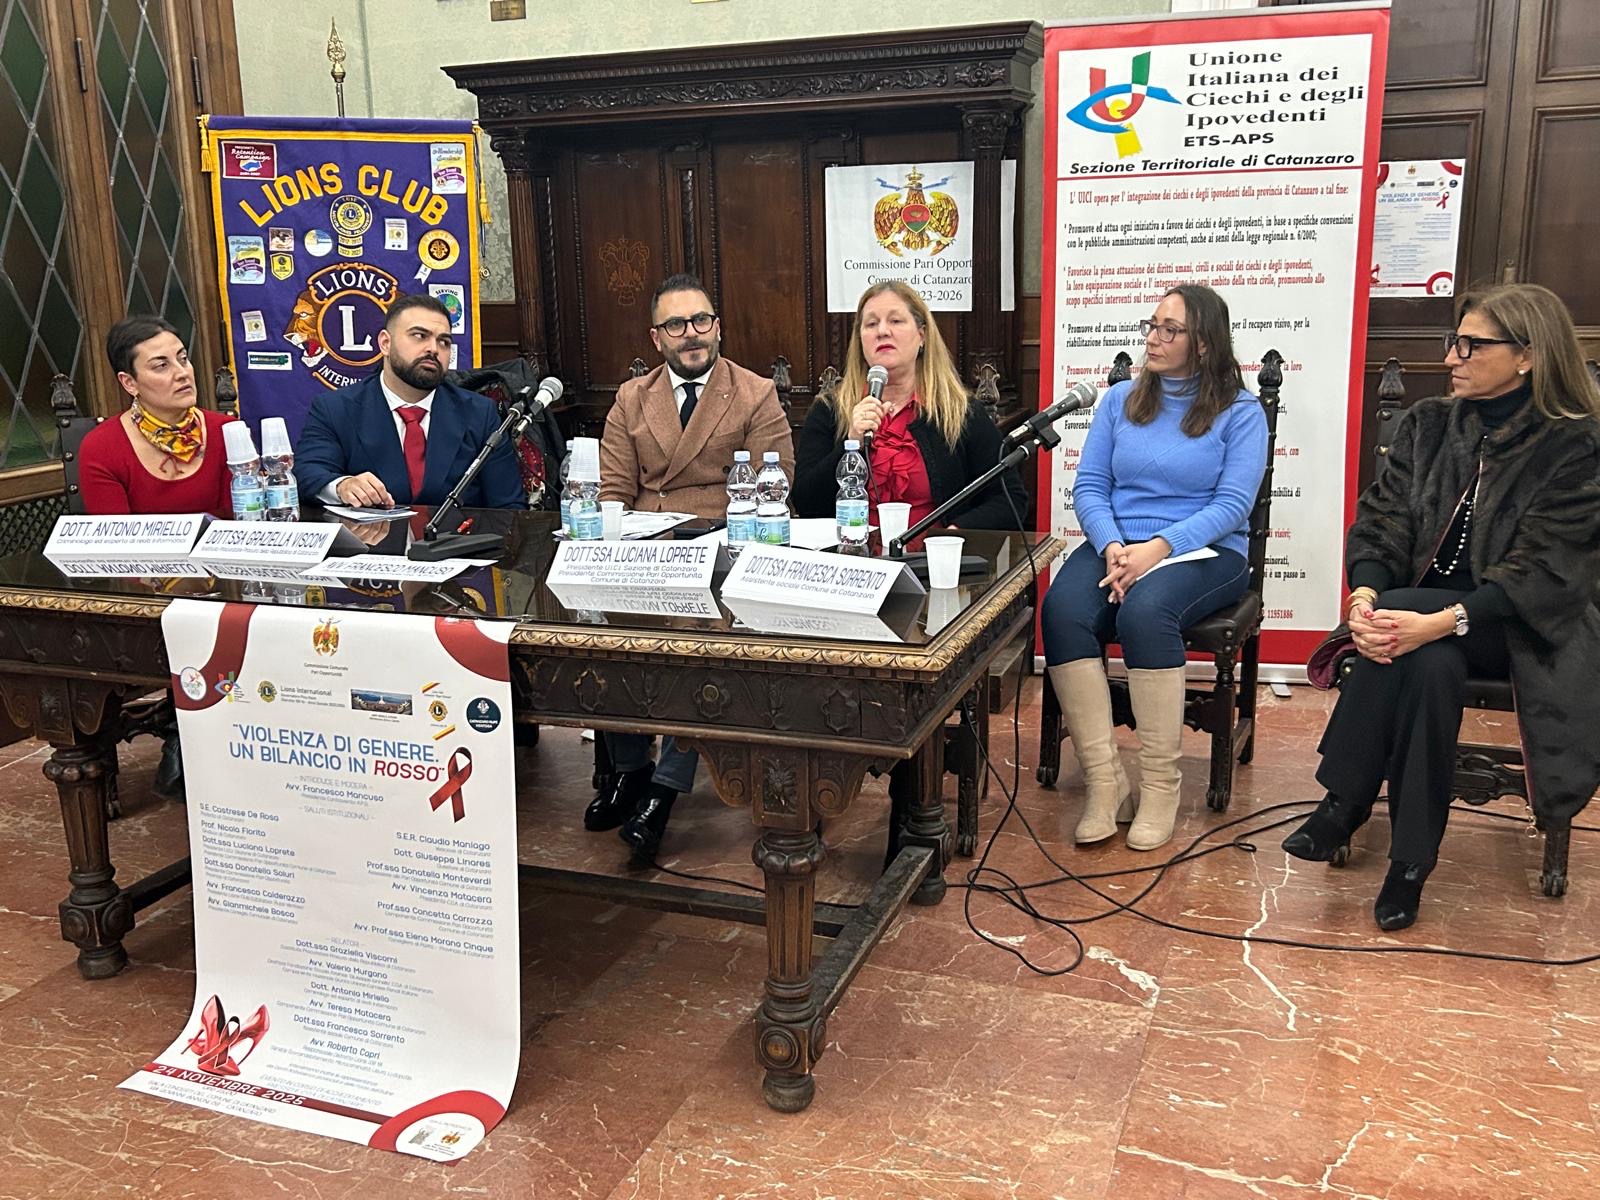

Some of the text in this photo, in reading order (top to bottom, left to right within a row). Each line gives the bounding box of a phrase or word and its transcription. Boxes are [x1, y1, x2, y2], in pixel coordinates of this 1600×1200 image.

[1189, 51, 1282, 66] Unione
[1186, 66, 1338, 86] Italiana dei
[1186, 86, 1364, 107] Ciechi e degli
[1185, 108, 1327, 129] Ipovedenti
[1184, 133, 1274, 147] ETS-APS
[1069, 153, 1354, 174] Sezione Territoriale di Catanzaro
[239, 163, 342, 227] LIONS
[358, 165, 448, 226] CLUB
[1078, 191, 1092, 203] UICI
[1094, 196, 1109, 206] opera
[1111, 195, 1120, 206] per
[1128, 191, 1160, 204] integrazione
[1163, 190, 1171, 200] dei
[1173, 189, 1188, 199] ciechi
[1195, 188, 1209, 202] degli
[1211, 187, 1240, 201] ipovedenti
[1242, 186, 1254, 197] della
[1257, 185, 1282, 199] provincia
[1285, 185, 1290, 195] di
[1292, 185, 1318, 195] Catanzaro
[1336, 183, 1348, 194] fine:
[1069, 224, 1094, 233] Promuove
[1096, 223, 1102, 232] ed
[1104, 223, 1118, 232] attua
[1120, 221, 1132, 234] ogni
[1134, 221, 1159, 231] iniziativa
[1166, 219, 1183, 230] favore
[1185, 219, 1193, 229] dei
[1195, 218, 1211, 229] ciechi
[1218, 217, 1231, 231] degli
[1234, 216, 1264, 230] ipovedenti,
[1266, 216, 1272, 226] in
[1274, 215, 1286, 226] base
[1293, 214, 1318, 228] specifiche
[1320, 214, 1353, 225] convenzioni
[844, 260, 910, 270] Commissione
[914, 259, 933, 268] Pari
[316, 270, 389, 296] LIONS
[911, 275, 920, 284] di
[918, 290, 962, 300] 23-2026
[339, 305, 373, 350] L
[1232, 318, 1309, 332] per il recupero visivo, per la
[318, 365, 361, 386] INTERN
[60, 521, 192, 536] DOTT. ANTONIO MIRIELLO
[292, 532, 329, 548] VISCOMI
[563, 547, 708, 563] DOTT.SSA LUCIANA LOPRETE
[787, 562, 838, 584] FRANCESCA
[836, 567, 887, 590] SORRENTO
[741, 576, 775, 587] Assistente
[776, 581, 799, 589] sociale
[801, 584, 829, 593] Comune
[839, 589, 874, 599] Catanzaro
[230, 741, 254, 760] UN
[261, 746, 341, 771] BILANCIO
[350, 756, 366, 773] IN
[334, 735, 351, 752] DI
[359, 738, 439, 763] GENERE.
[286, 783, 301, 791] Avv.
[303, 785, 344, 796] Francesco
[346, 790, 384, 802] Mancuso
[248, 810, 258, 818] De
[260, 812, 279, 821] Rosa
[201, 820, 215, 829] Prof.
[218, 824, 240, 833] Nicola
[242, 827, 266, 837] Fiorita
[233, 841, 263, 852] Luciana
[265, 846, 295, 856] Loprete
[419, 835, 450, 846] Claudio
[453, 840, 490, 851] Maniago
[394, 848, 413, 858] Dott.
[416, 852, 454, 864] Giuseppe
[457, 858, 490, 868] Linares
[235, 863, 272, 875] Donatella
[402, 866, 440, 879] Donatella
[442, 872, 491, 885] Monteverdi
[207, 881, 305, 904] Avv. Francesco Calderazzo
[412, 907, 450, 920] Concetta
[452, 914, 492, 926] Carrozza
[354, 923, 369, 931] Avv.
[406, 932, 428, 942] Elena
[431, 936, 461, 948] Morano
[463, 942, 493, 953] Cinque
[330, 945, 364, 958] Graziella
[366, 951, 398, 963] Viscomi
[309, 959, 388, 979] Avv. Valerio Murgano
[311, 981, 389, 1003] Dott. Antonio Miriello
[327, 1021, 368, 1036] Francesca
[370, 1030, 405, 1044] Sorrento
[153, 1065, 175, 1076] 24
[177, 1071, 261, 1095] NOVEMBRE
[261, 1090, 307, 1105] 2025
